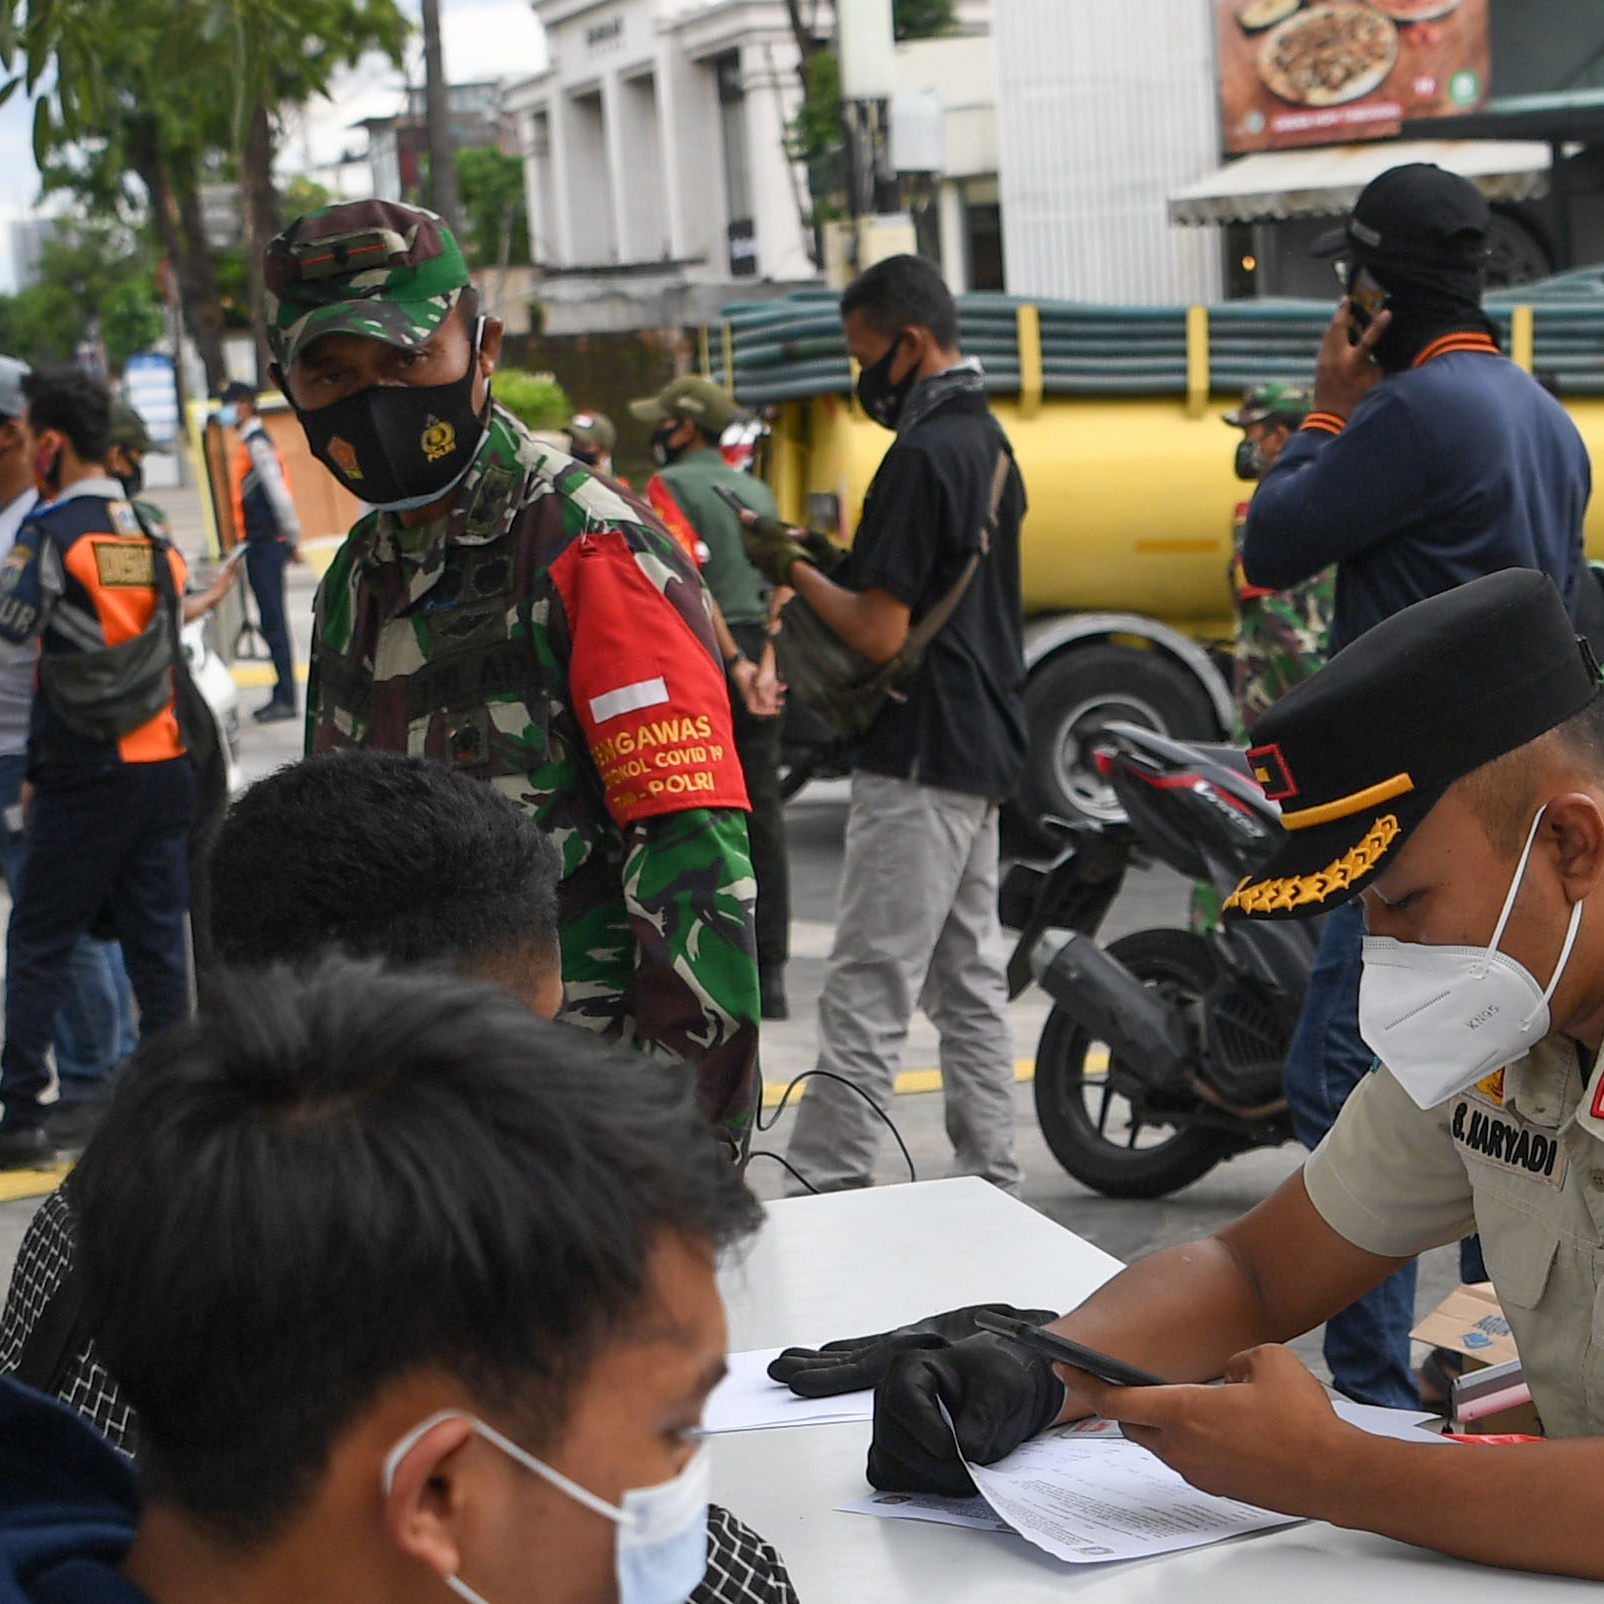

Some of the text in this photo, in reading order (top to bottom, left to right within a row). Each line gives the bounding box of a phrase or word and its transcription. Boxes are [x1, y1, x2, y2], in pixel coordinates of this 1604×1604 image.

[654, 745, 707, 768] COVID
[709, 744, 724, 761] 19
[648, 770, 716, 797] POLRI
[1466, 1003, 1500, 1031] KN95
